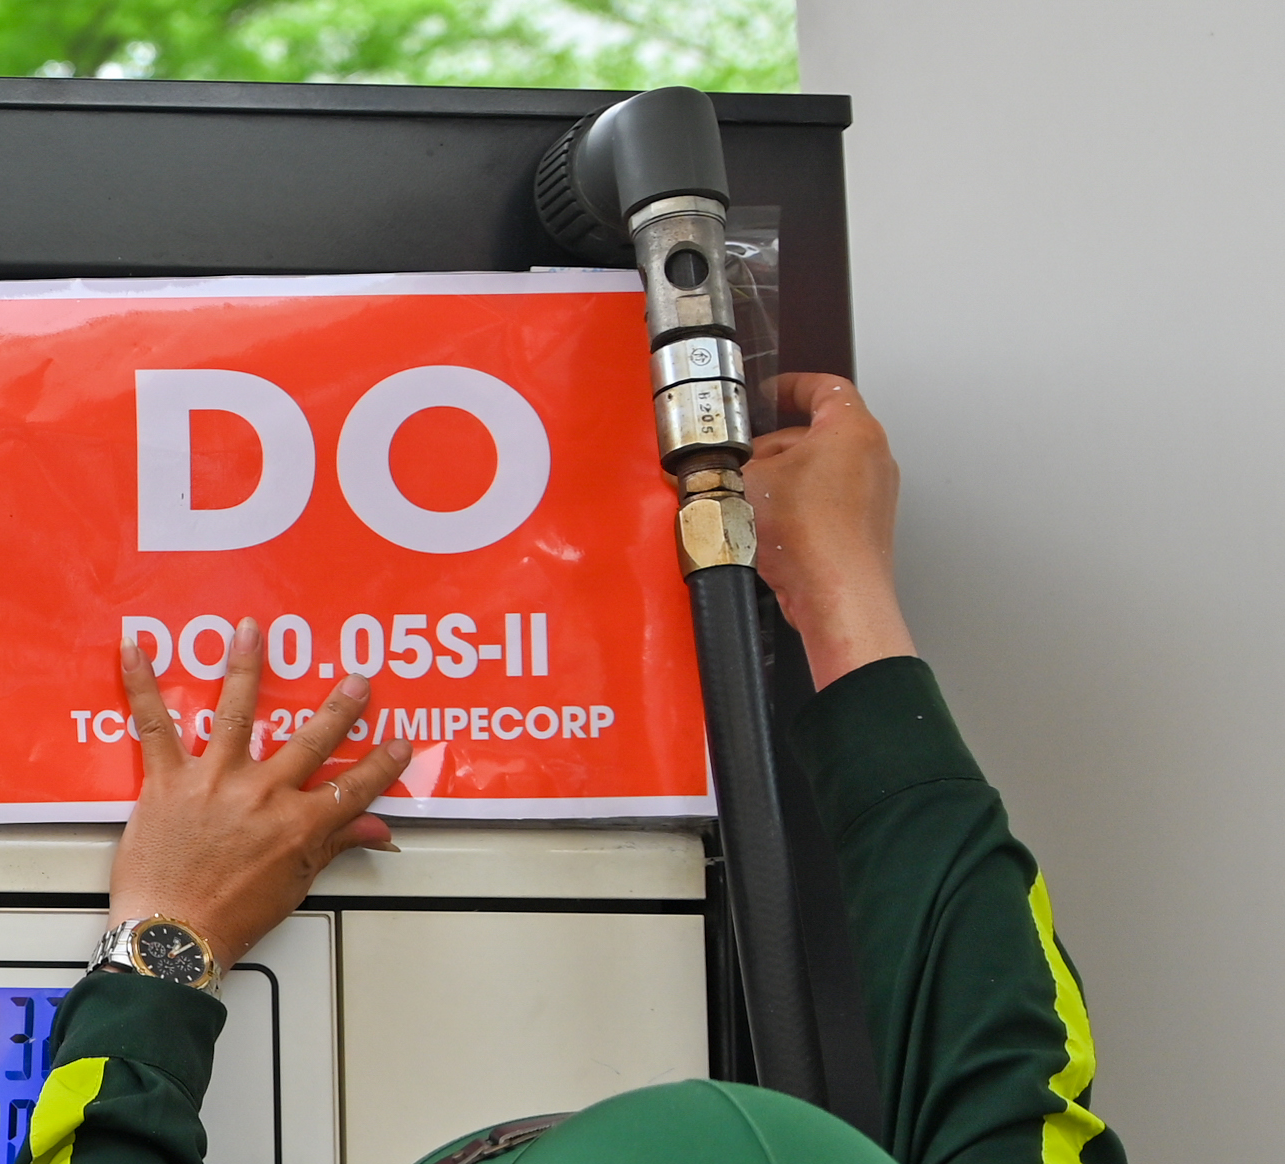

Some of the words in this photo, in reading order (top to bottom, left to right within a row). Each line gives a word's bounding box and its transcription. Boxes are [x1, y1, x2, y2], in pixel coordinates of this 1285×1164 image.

[135, 364, 551, 555] DO
[122, 614, 236, 680] DO
[268, 612, 548, 680] 0.05S-II
